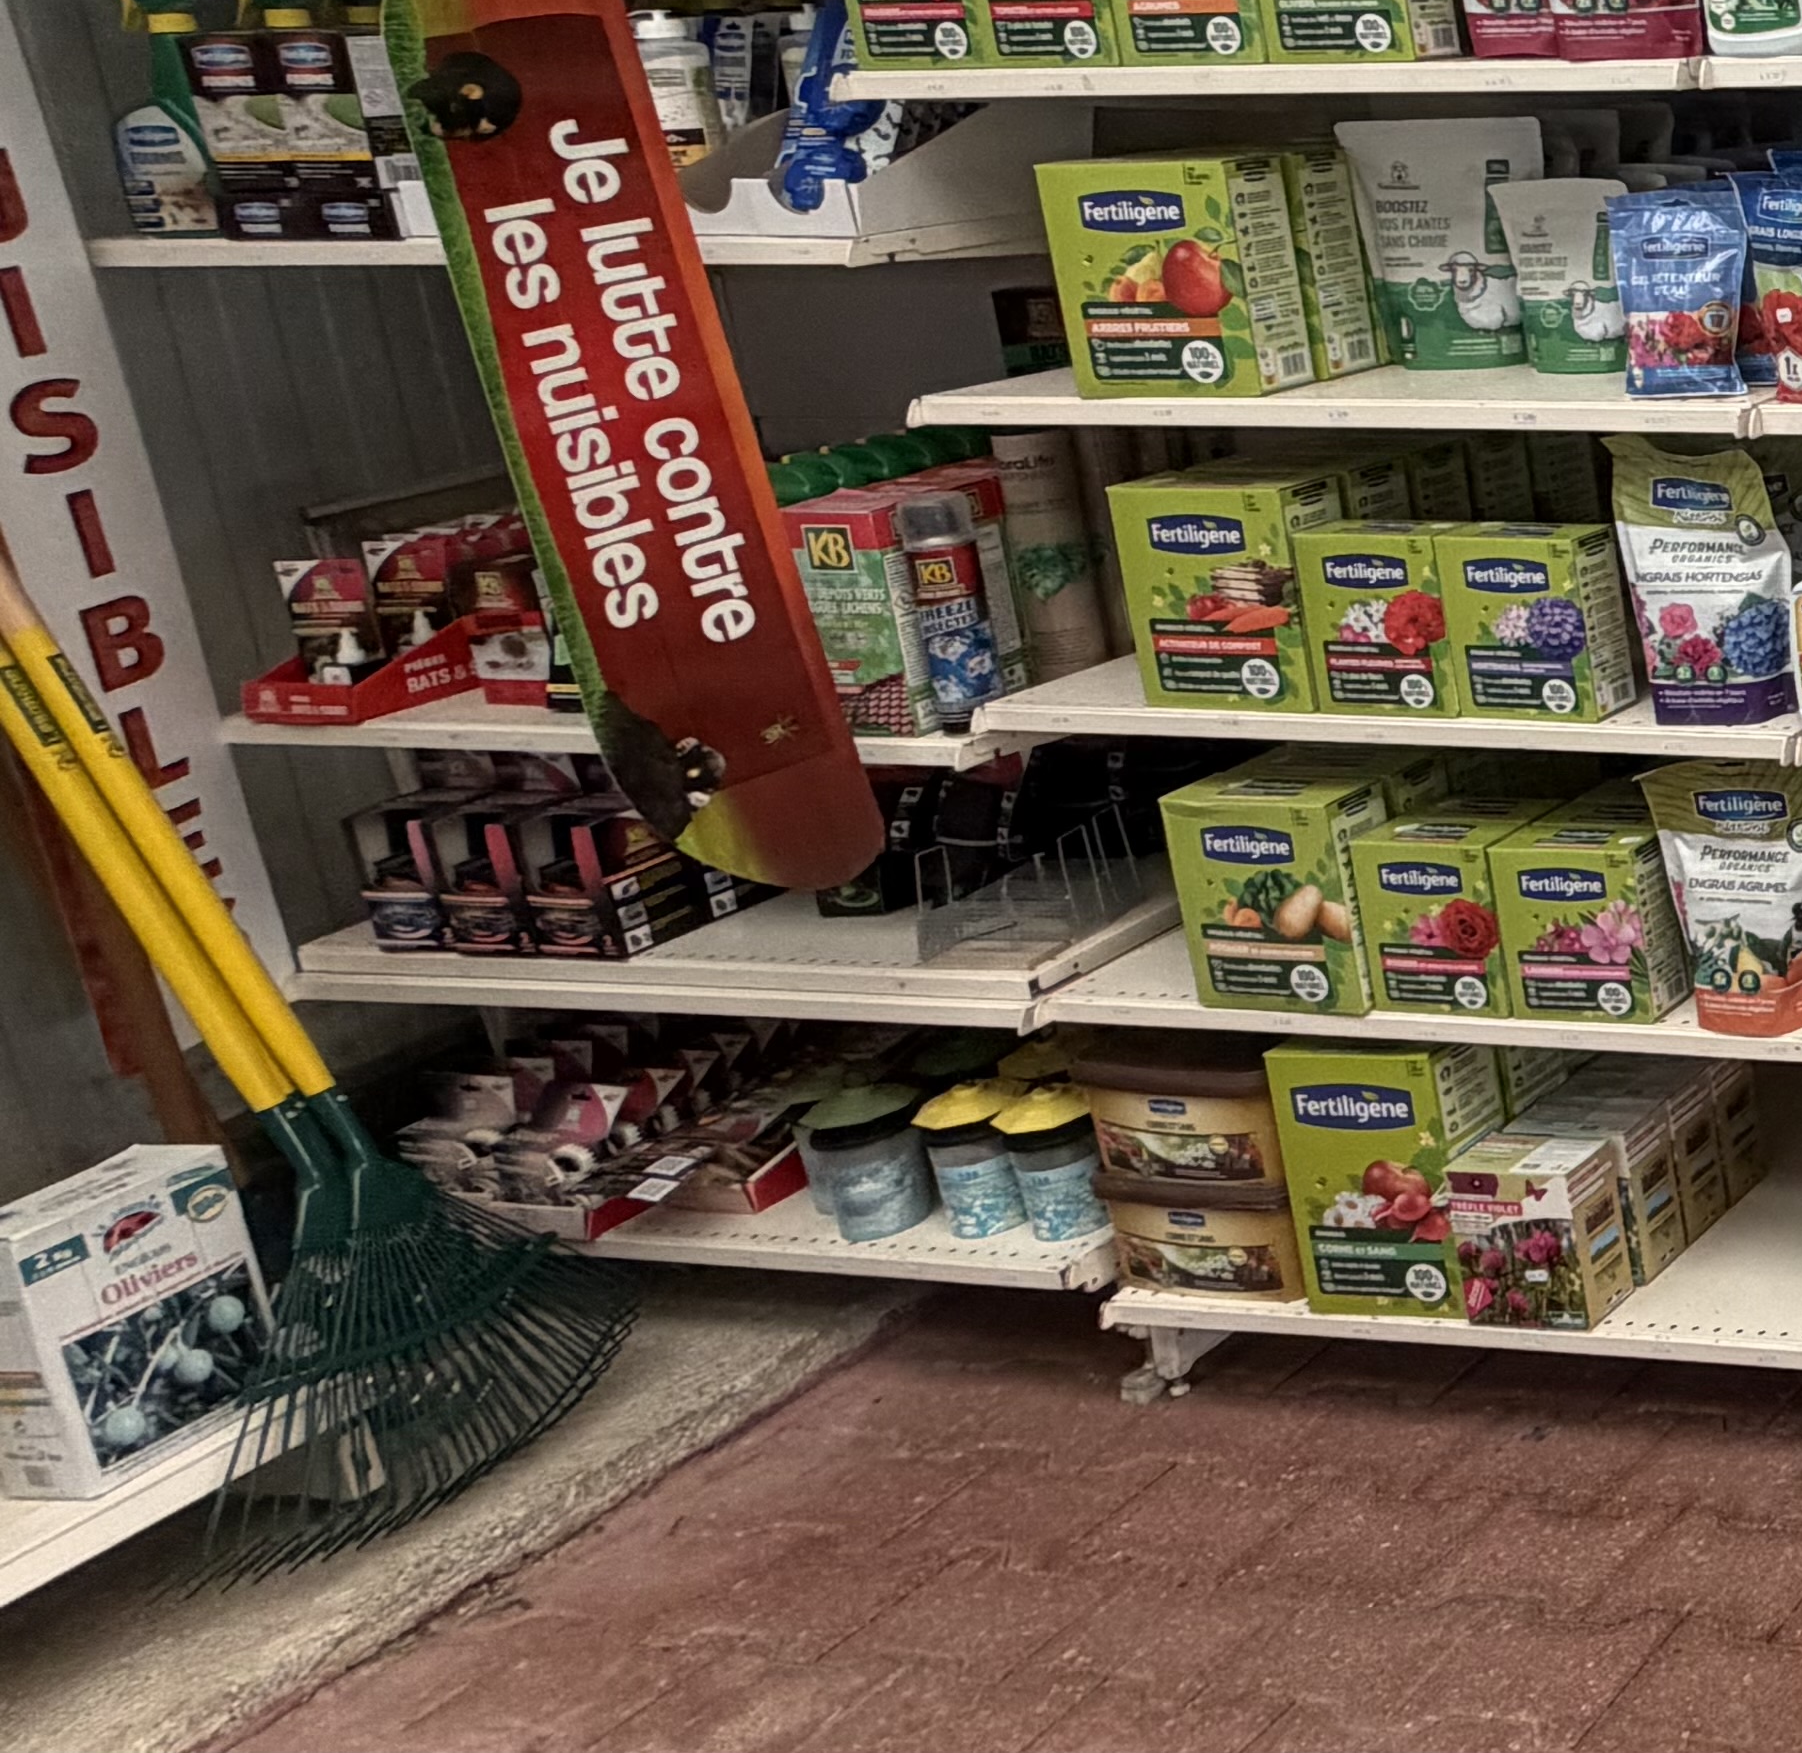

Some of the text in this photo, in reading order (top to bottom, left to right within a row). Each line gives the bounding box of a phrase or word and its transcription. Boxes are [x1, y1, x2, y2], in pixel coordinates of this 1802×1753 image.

[1082, 199, 1181, 225] Fertiligène
[1376, 200, 1428, 213] BOOSTEZ
[1406, 217, 1452, 231] PLANTES
[550, 118, 755, 642] Je lutte contre
[485, 199, 660, 630] les nuisibles
[1151, 523, 1241, 548] Fertiligène
[808, 530, 850, 567] KB
[921, 564, 951, 584] KB
[1325, 562, 1404, 584] Fertiligène
[1467, 565, 1546, 589] Fertiligène
[405, 668, 452, 695] RATS
[1699, 795, 1783, 814] Fertiligène
[1204, 833, 1290, 859] Fertiligène
[1700, 846, 1789, 863] PERFORMANCE
[1381, 868, 1459, 890] Fertiligène
[1520, 873, 1602, 896] Fertiligène
[1294, 1094, 1410, 1124] Fertiligène
[102, 1249, 197, 1307] Oliviers
